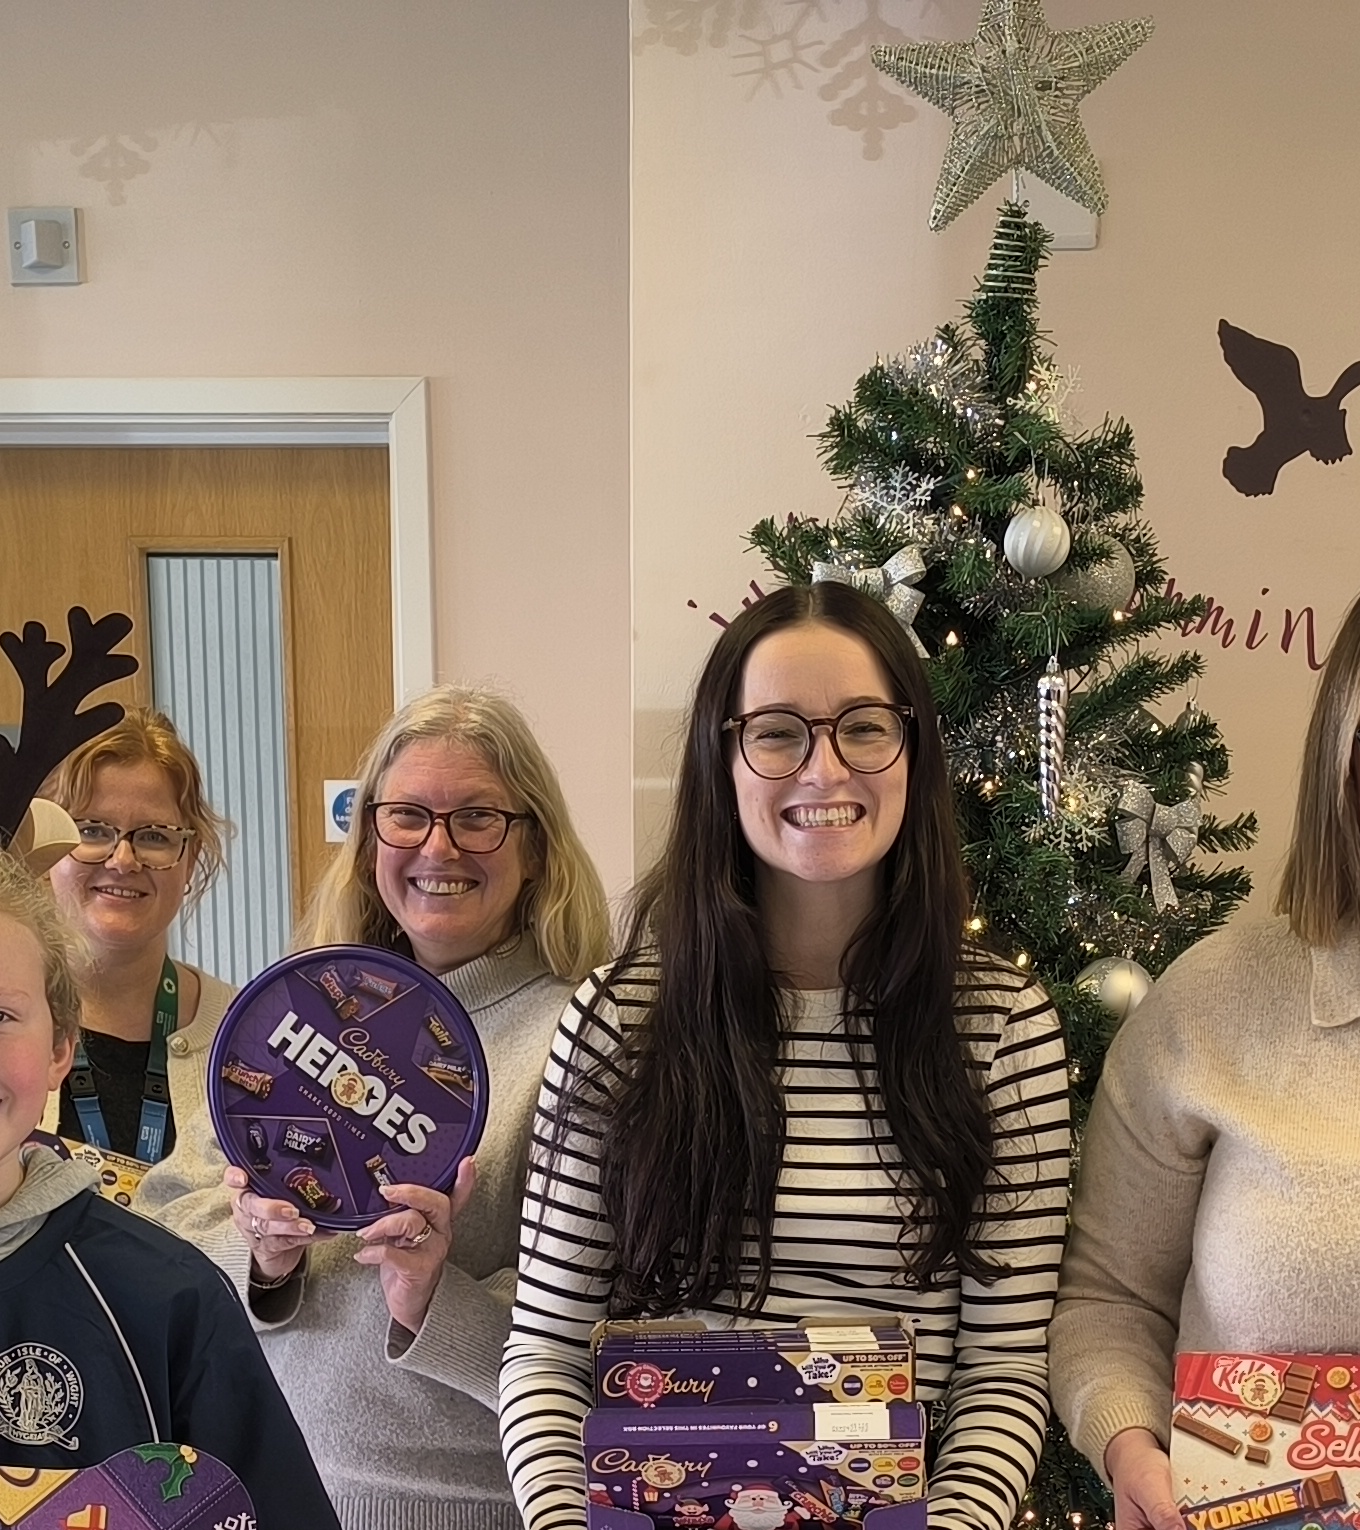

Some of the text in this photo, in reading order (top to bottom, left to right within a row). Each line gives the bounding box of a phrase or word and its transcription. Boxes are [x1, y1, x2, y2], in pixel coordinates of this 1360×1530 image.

[429, 1016, 452, 1046] Twirl
[339, 1027, 405, 1090] Cadbury
[298, 1085, 322, 1106] SHARE
[343, 1121, 366, 1140] TIMES
[283, 1139, 308, 1153] MILK
[285, 1130, 316, 1144] DAIRY
[842, 1354, 855, 1362] UP
[856, 1354, 867, 1362] TO
[868, 1354, 887, 1362] 50%
[17, 1347, 42, 1357] ISLE
[48, 1353, 63, 1365] OF
[65, 1371, 80, 1408] WIGHT
